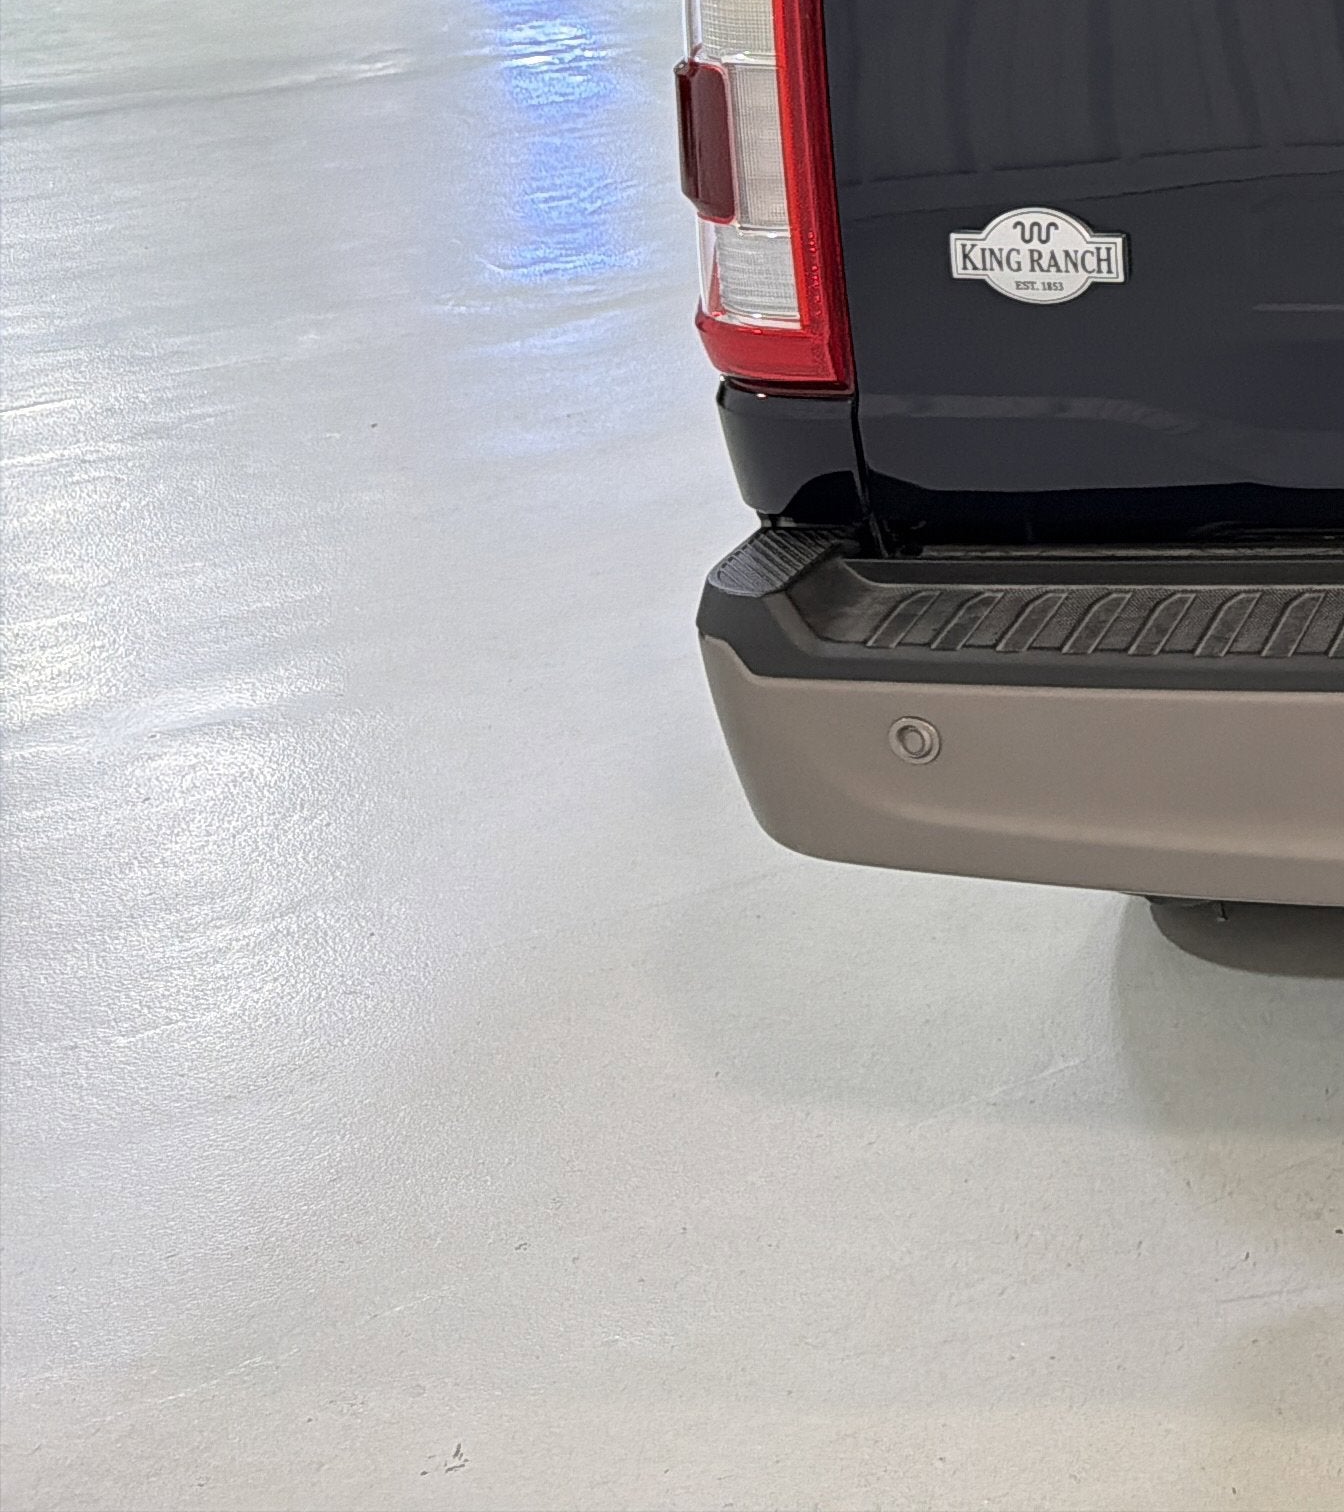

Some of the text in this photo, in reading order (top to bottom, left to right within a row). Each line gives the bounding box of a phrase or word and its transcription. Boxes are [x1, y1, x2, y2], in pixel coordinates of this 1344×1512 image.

[960, 243, 1115, 275] KING RANCH
[1015, 281, 1065, 292] EST. 1853
